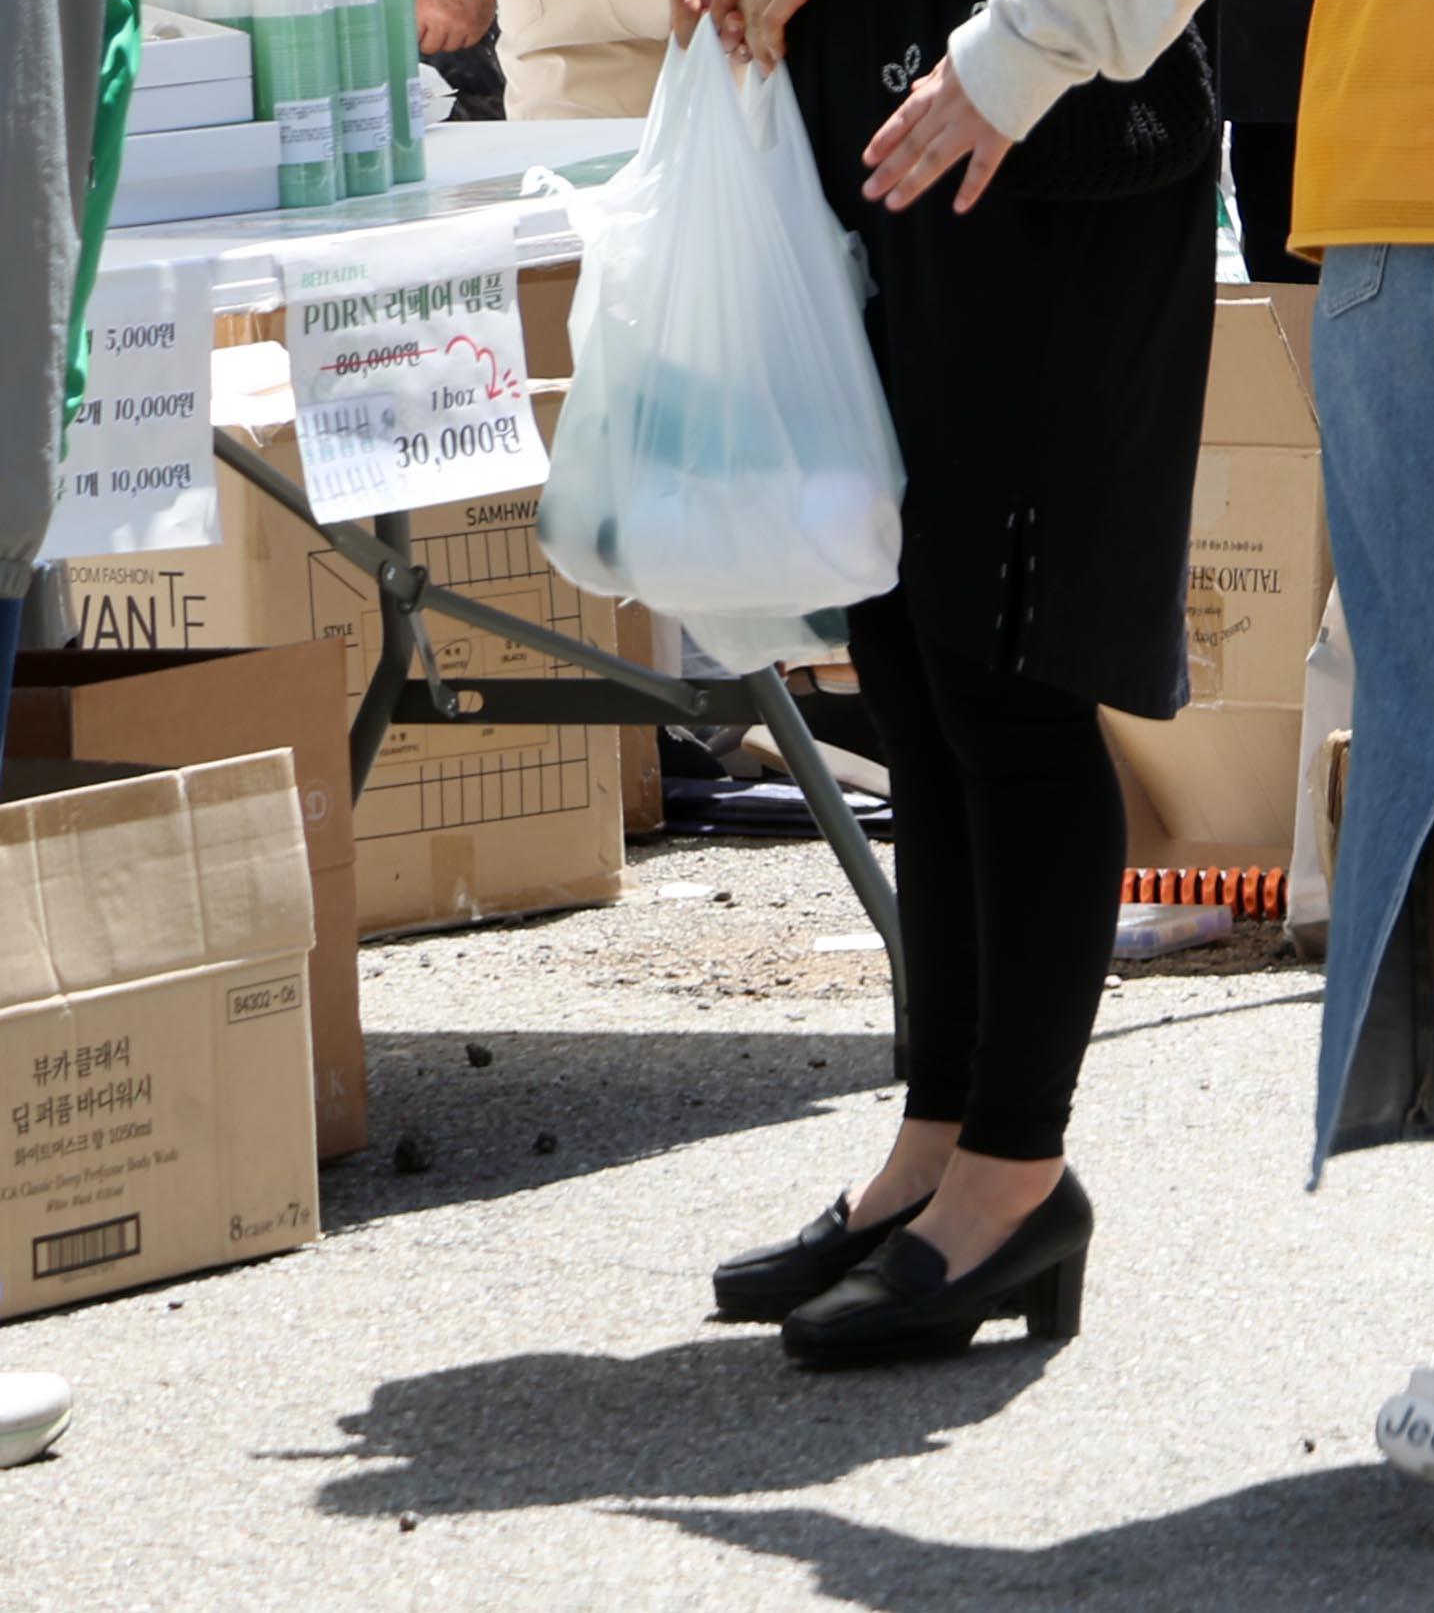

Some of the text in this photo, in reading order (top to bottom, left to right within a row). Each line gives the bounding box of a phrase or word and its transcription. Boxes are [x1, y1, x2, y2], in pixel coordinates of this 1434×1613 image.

[303, 297, 378, 335] PDRN
[104, 322, 176, 352] 5,000원
[113, 391, 195, 422] 10,000원
[442, 385, 476, 410] box
[393, 418, 523, 473] 30,000원
[111, 463, 192, 496] 10,000원
[106, 565, 155, 585] FASHION
[1217, 566, 1282, 594] TALMO
[323, 623, 353, 638] STYLE
[75, 1035, 131, 1079] 클래식
[12, 1100, 31, 1136] 딥
[77, 1073, 153, 1119] 바디워시
